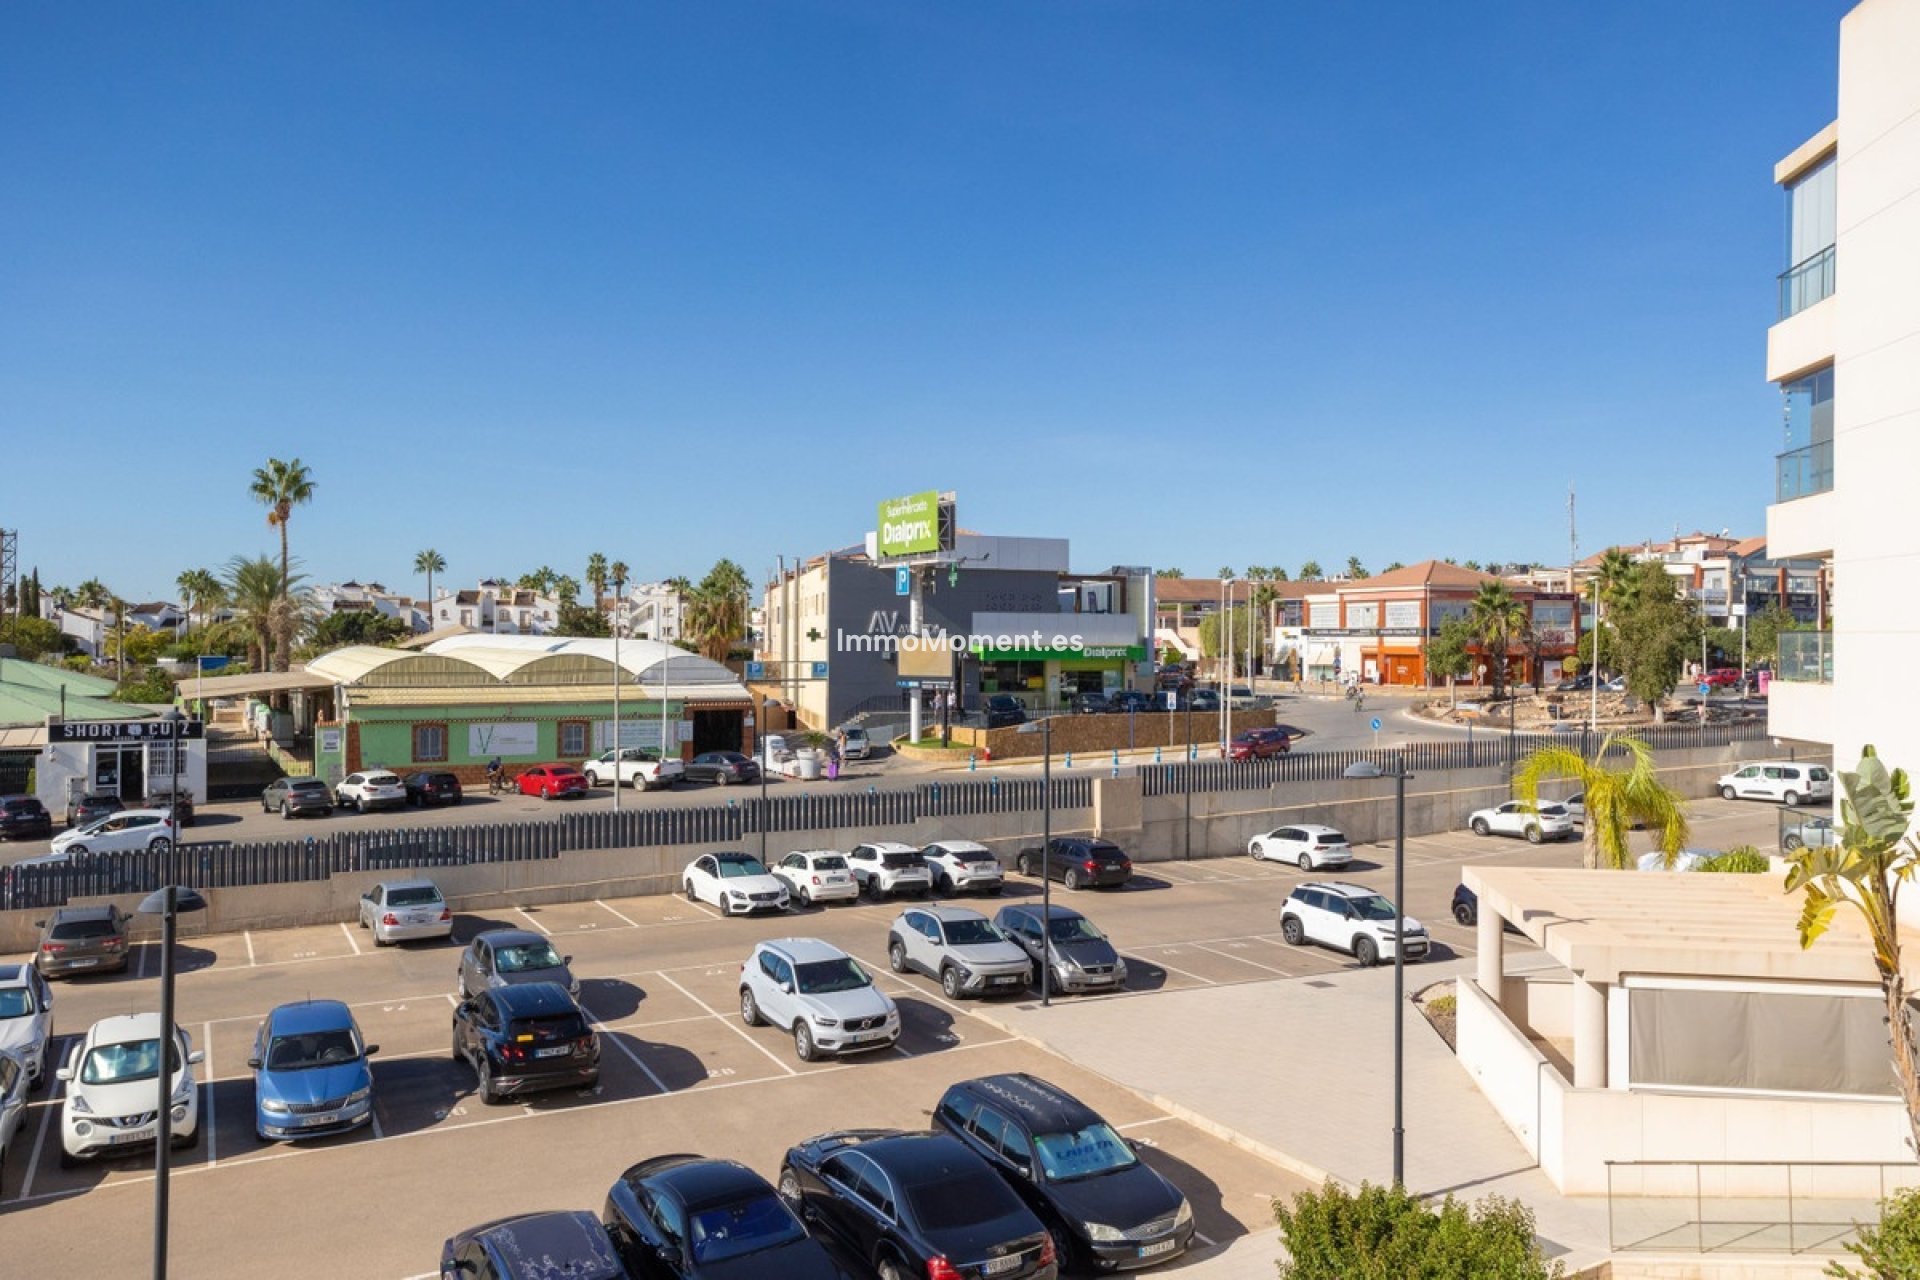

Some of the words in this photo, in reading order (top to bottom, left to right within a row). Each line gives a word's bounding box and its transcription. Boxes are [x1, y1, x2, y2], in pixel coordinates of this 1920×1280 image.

[898, 569, 906, 591] P
[64, 723, 121, 737] SHORT
[148, 721, 190, 735] CUZ
